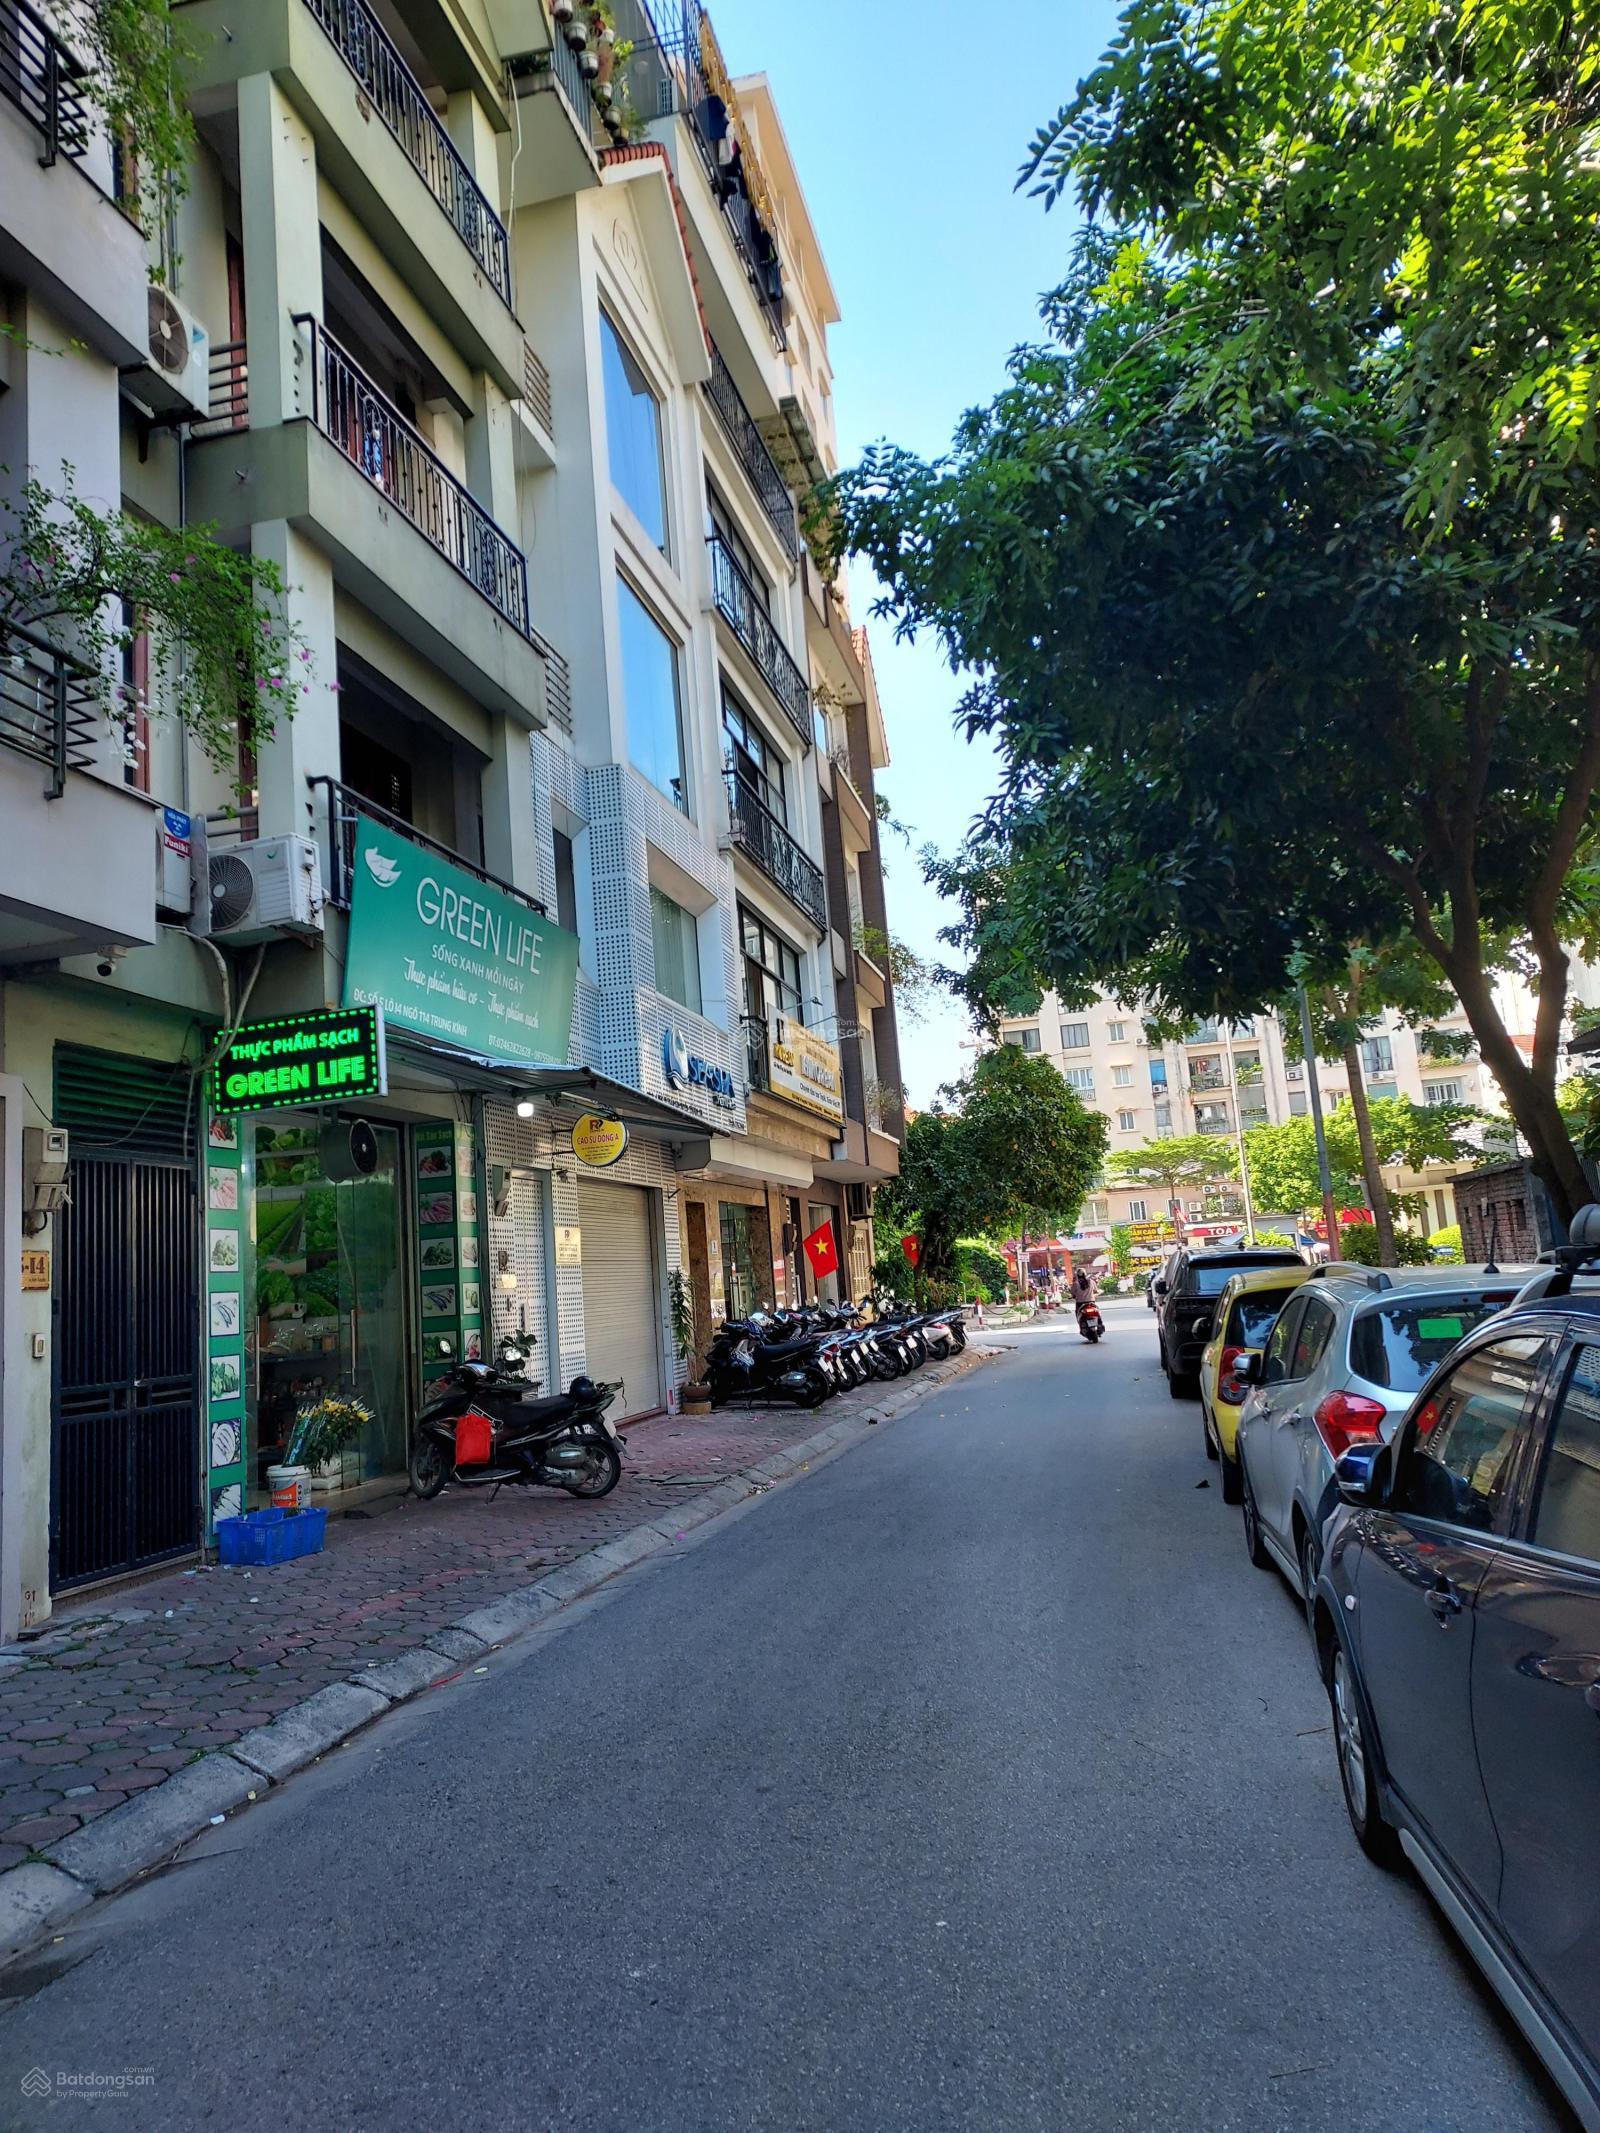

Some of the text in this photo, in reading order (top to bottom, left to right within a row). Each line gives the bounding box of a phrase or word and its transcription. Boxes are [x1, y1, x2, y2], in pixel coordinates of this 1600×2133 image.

[164, 834, 188, 853] Funiki
[416, 877, 543, 975] GREEN LIFE
[432, 943, 524, 994] SỐNG XANH MỖI NGÀY
[430, 1012, 451, 1033] TRUNG
[451, 1020, 468, 1037] KÍNH
[230, 1028, 360, 1062] THỰC PHẨM SẠCH
[225, 1055, 366, 1099] GREEN LIFE
[576, 1136, 588, 1145] CAO
[589, 1135, 597, 1144] SU
[21, 1256, 46, 1274] -14
